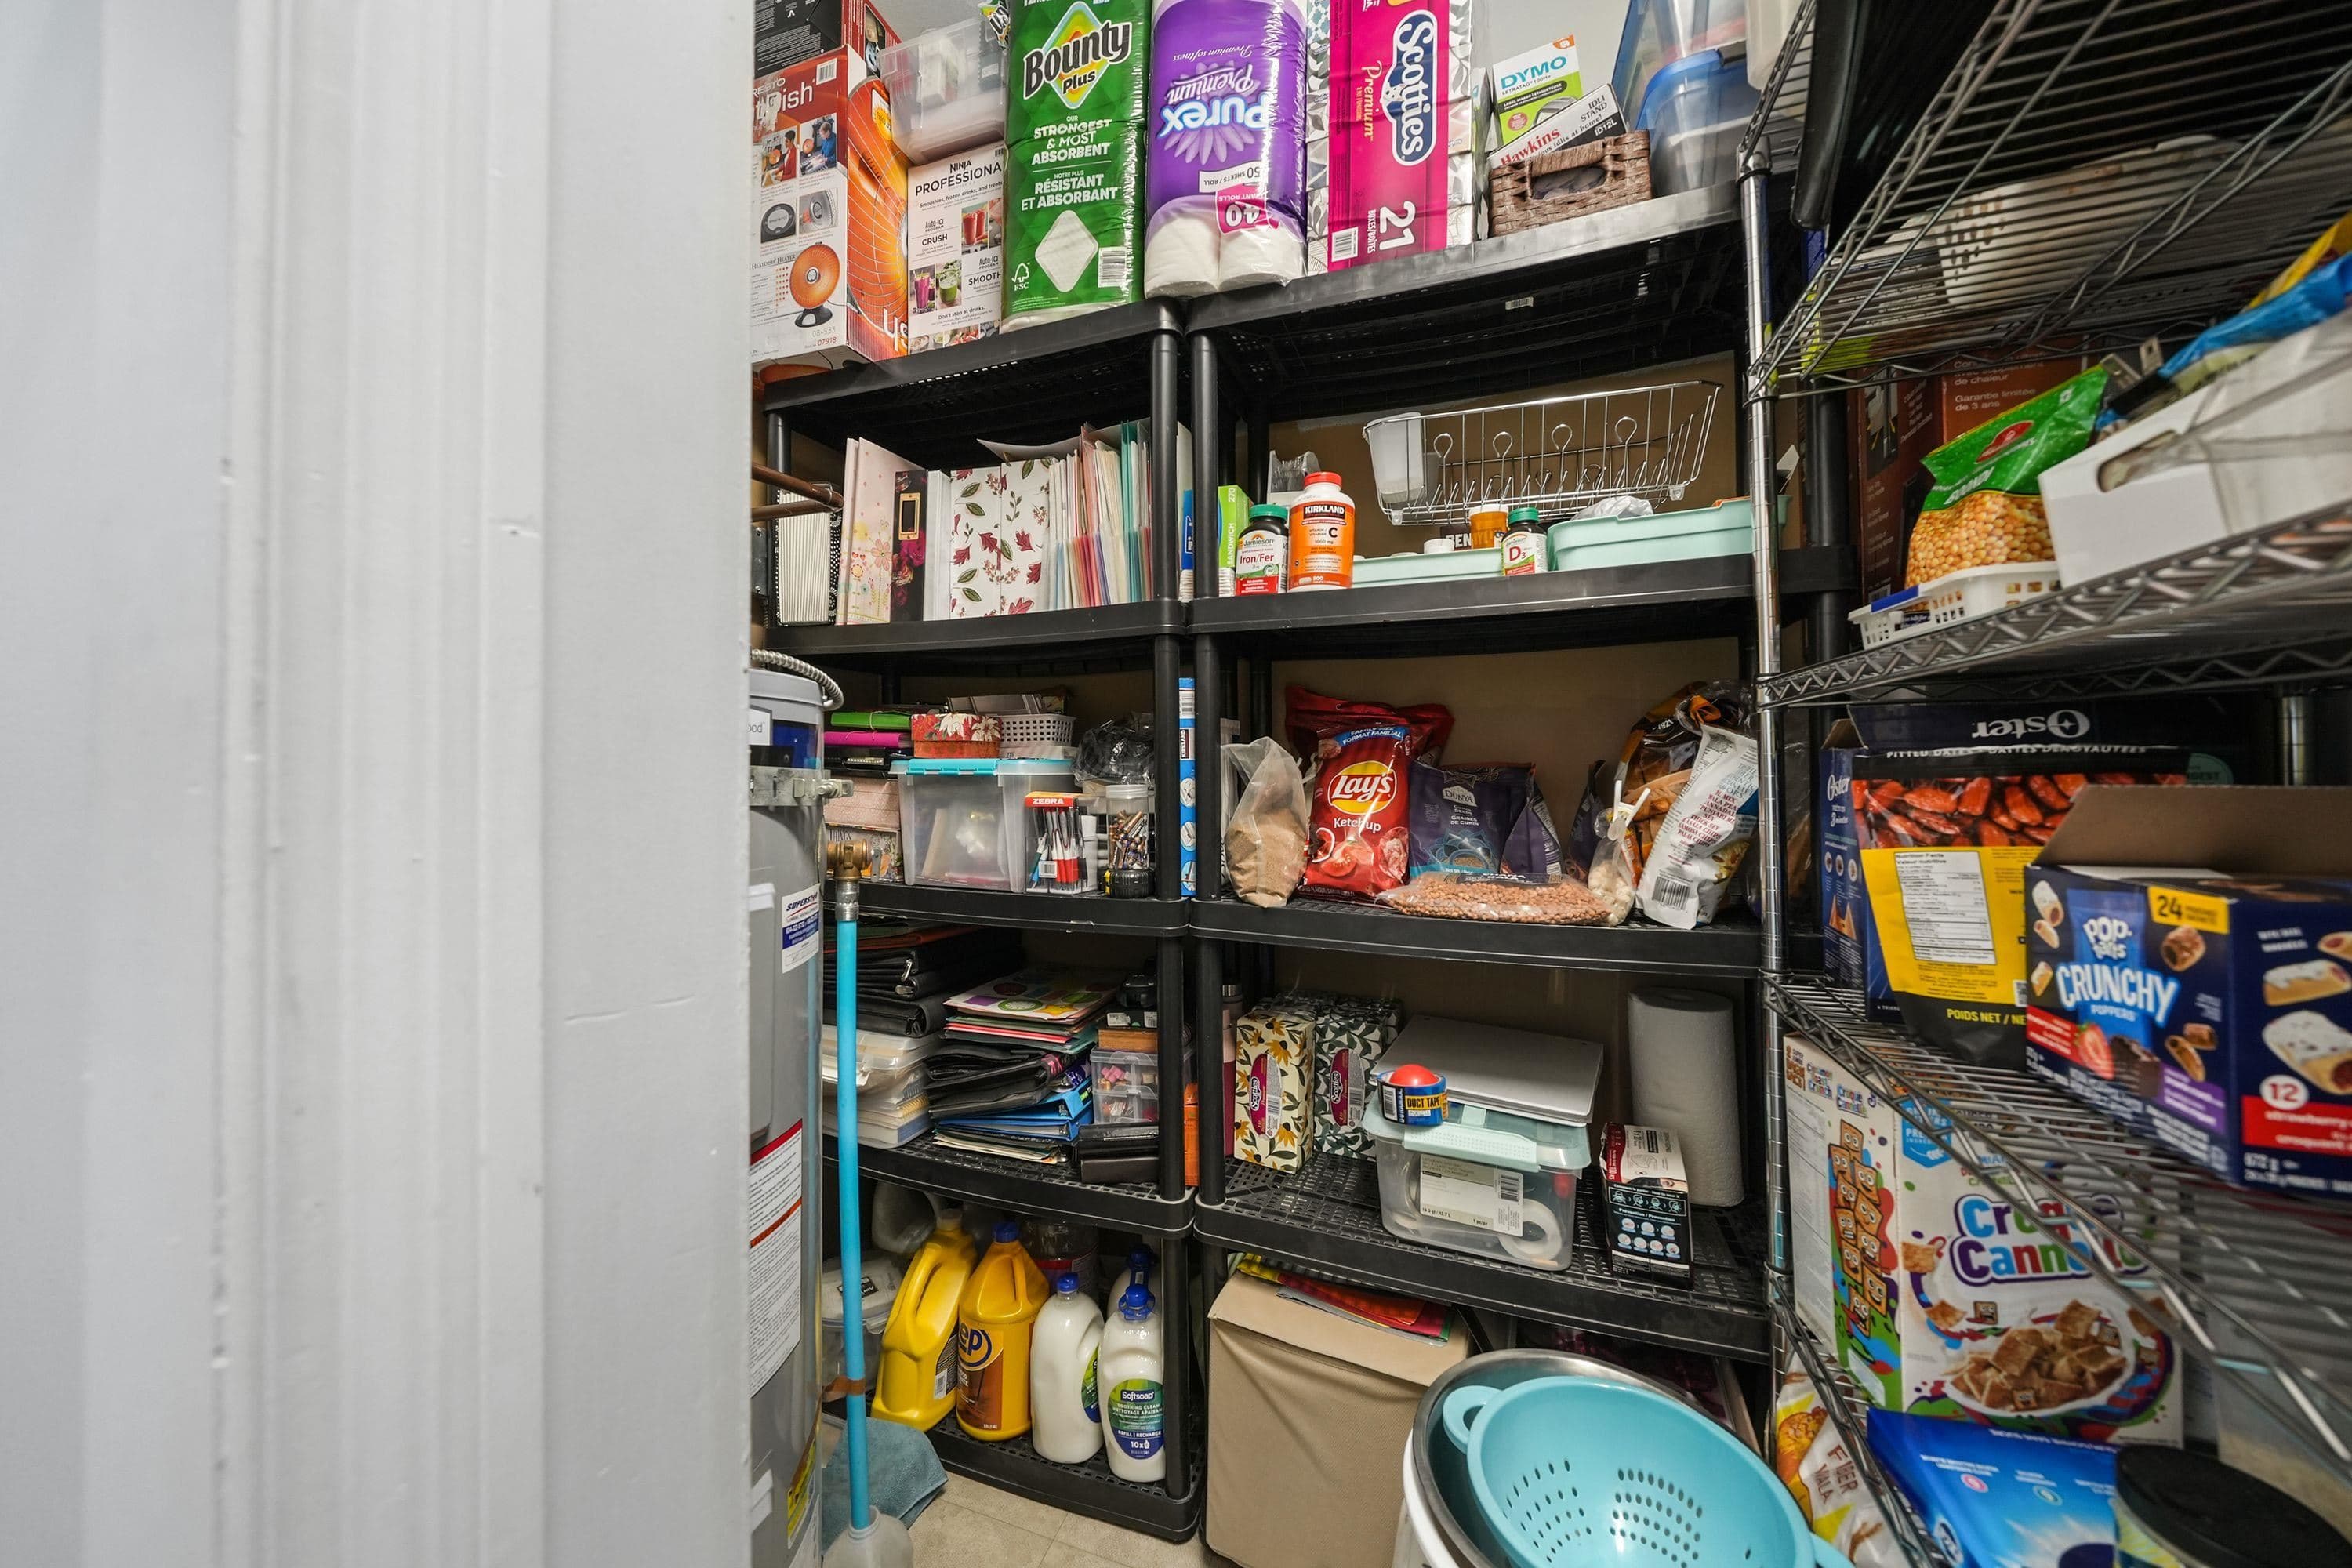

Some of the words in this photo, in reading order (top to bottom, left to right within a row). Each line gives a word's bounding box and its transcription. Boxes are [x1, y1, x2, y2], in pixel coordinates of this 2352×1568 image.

[1023, 20, 1132, 100] Bounty
[1172, 49, 1206, 62] softness
[1208, 44, 1254, 58] Premium
[1501, 56, 1567, 89] DYMO
[1063, 71, 1096, 95] Plus
[1165, 63, 1254, 104] Premium
[1398, 21, 1434, 157] Scotties
[1361, 60, 1383, 140] Premium
[1588, 95, 1606, 110] IDLI
[1157, 91, 1276, 139] Purex
[1581, 102, 1607, 122] STAND
[1034, 119, 1112, 139] STRONGEST
[1046, 138, 1056, 149] &
[1059, 131, 1096, 147] MOST
[1501, 129, 1561, 165] Hawkins
[1032, 142, 1111, 165] ABSORBENT
[949, 160, 972, 174] NINJA
[1223, 171, 1245, 182] SHEETS
[1035, 174, 1104, 194] RÉSISTANT
[920, 197, 945, 208] Smoothies,
[946, 193, 961, 201] frozen
[1021, 197, 1035, 211] ET
[1037, 187, 1118, 208] ABSORBANT
[1225, 202, 1261, 227] 40
[1379, 201, 1416, 251] 21
[922, 234, 948, 246] CRUSH
[1014, 280, 1029, 292] FSC
[817, 336, 837, 347] 07918
[1305, 505, 1345, 514] KIRKLAND
[1244, 538, 1274, 547] Jamieson
[1328, 527, 1338, 538] C
[1240, 553, 1274, 564] Iron/Fer
[1971, 710, 2091, 739] Oster
[1343, 731, 1372, 745] FORMAT
[1886, 750, 1929, 759] PITTED
[1331, 773, 1394, 802] Lay's
[1445, 789, 1473, 803] DUNYA
[1827, 774, 1850, 802] Oster
[1334, 817, 1381, 833] Ketchup
[829, 830, 852, 842] THINGS
[2157, 895, 2182, 920] 24
[2056, 963, 2178, 1024] CRUNCHY
[1947, 1007, 1978, 1022] POIDS
[1980, 1011, 2003, 1023] NET
[1251, 1078, 1261, 1110] Scotties
[1332, 1072, 1341, 1104] Scotties
[2270, 1083, 2299, 1103] 12
[1407, 1097, 1425, 1109] DUCT
[1427, 1096, 1440, 1108] TAPE
[1122, 1391, 1154, 1402] Softsoap
